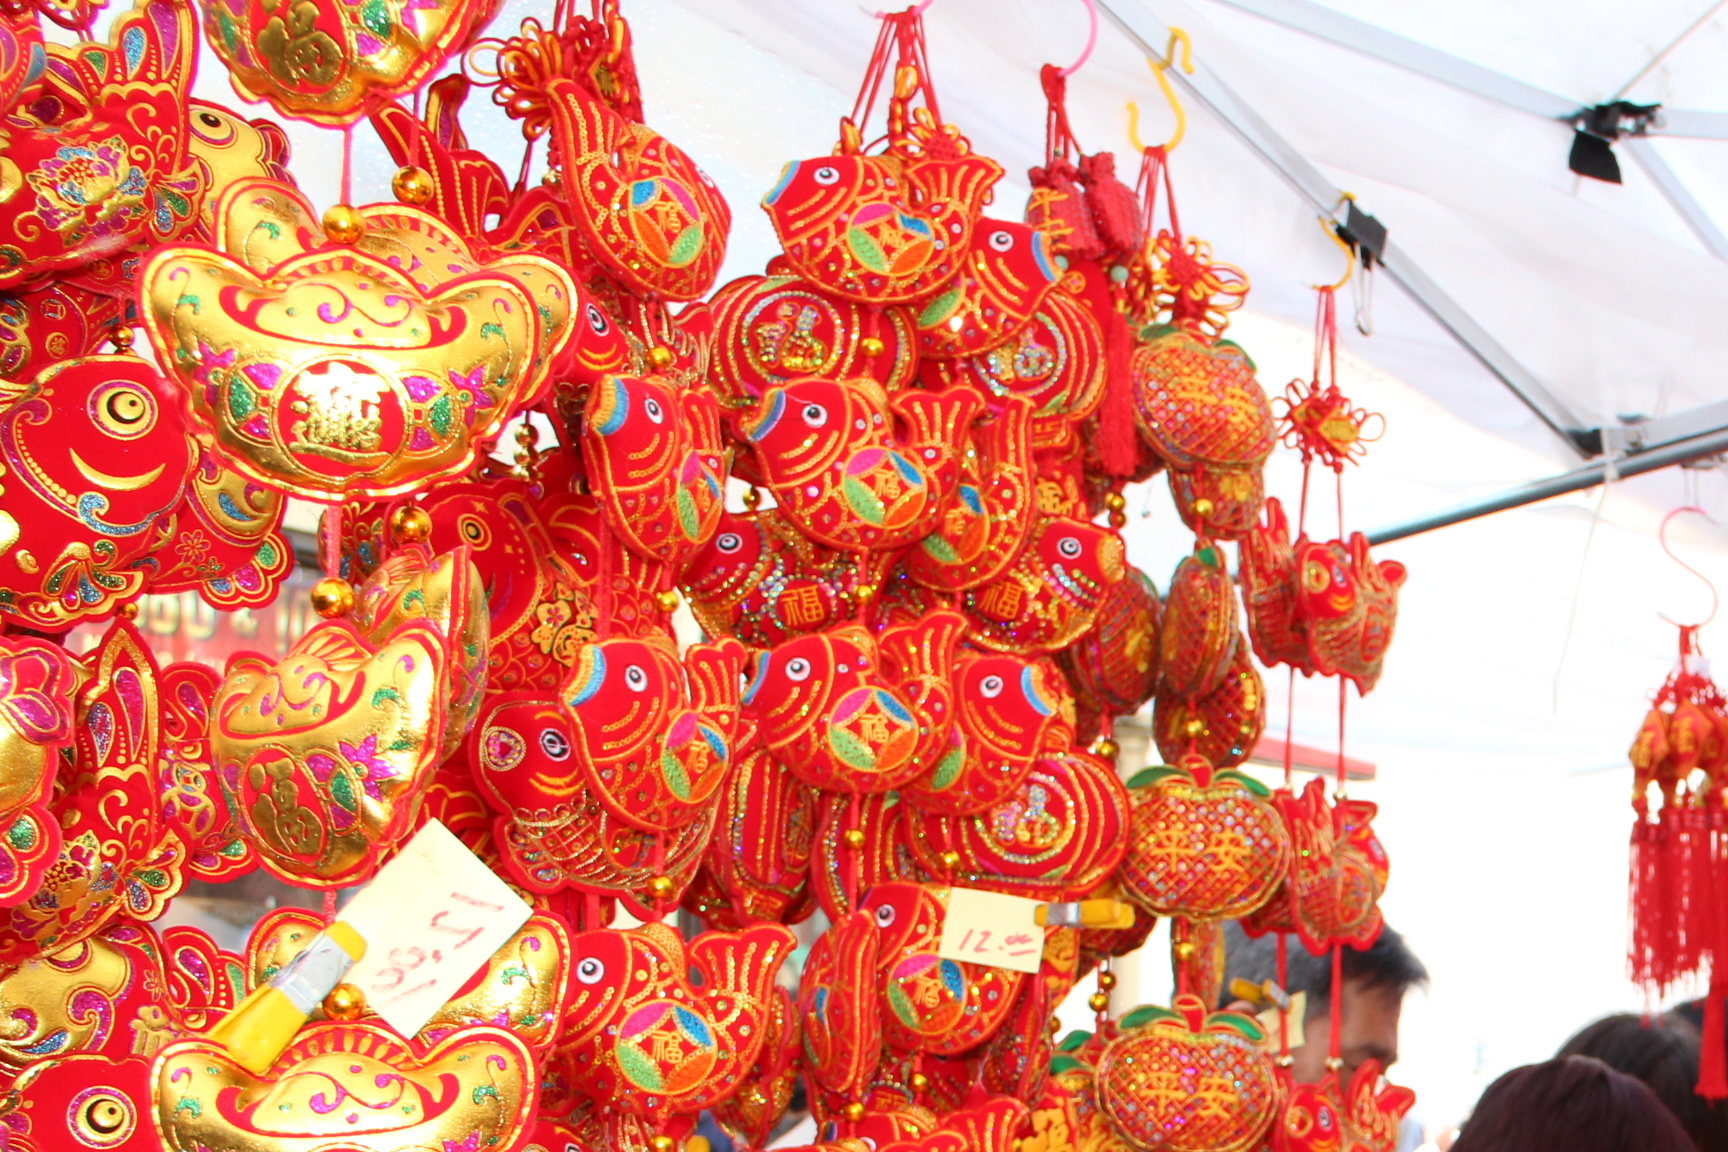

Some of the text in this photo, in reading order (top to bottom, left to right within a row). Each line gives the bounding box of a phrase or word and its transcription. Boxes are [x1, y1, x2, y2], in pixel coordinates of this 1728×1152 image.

[257, 0, 344, 87] 福
[875, 471, 902, 500] 福
[781, 586, 827, 626] 福
[980, 583, 1024, 624] 福
[860, 713, 890, 745] 福
[249, 757, 326, 856] 福
[1149, 828, 1253, 873] 平安
[652, 1030, 683, 1064] 福
[1138, 1072, 1239, 1118] 平安
